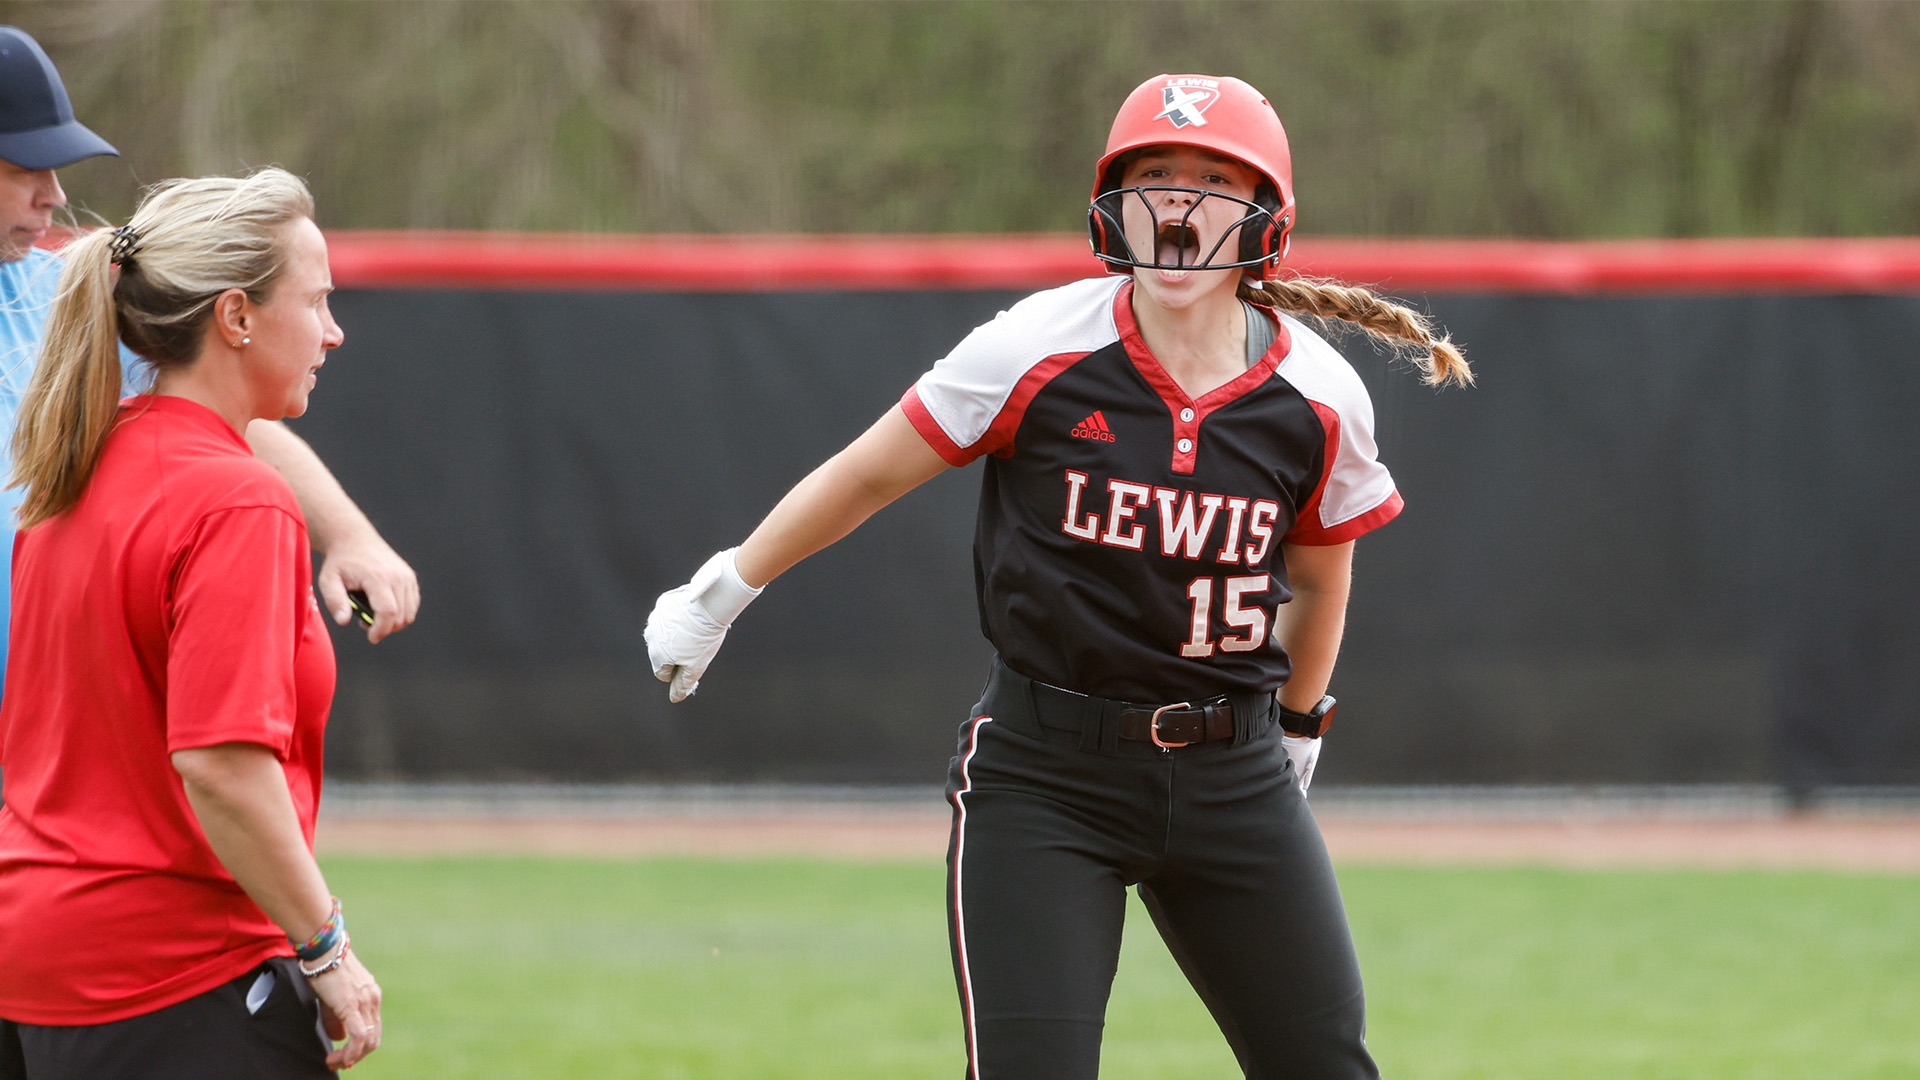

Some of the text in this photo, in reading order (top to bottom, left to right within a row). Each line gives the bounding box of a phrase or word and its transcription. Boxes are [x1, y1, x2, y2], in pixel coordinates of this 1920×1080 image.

[1166, 78, 1219, 88] LEWIS
[1071, 426, 1116, 443] adidas
[1062, 469, 1279, 566] LEWIS
[1179, 572, 1271, 658] 15
